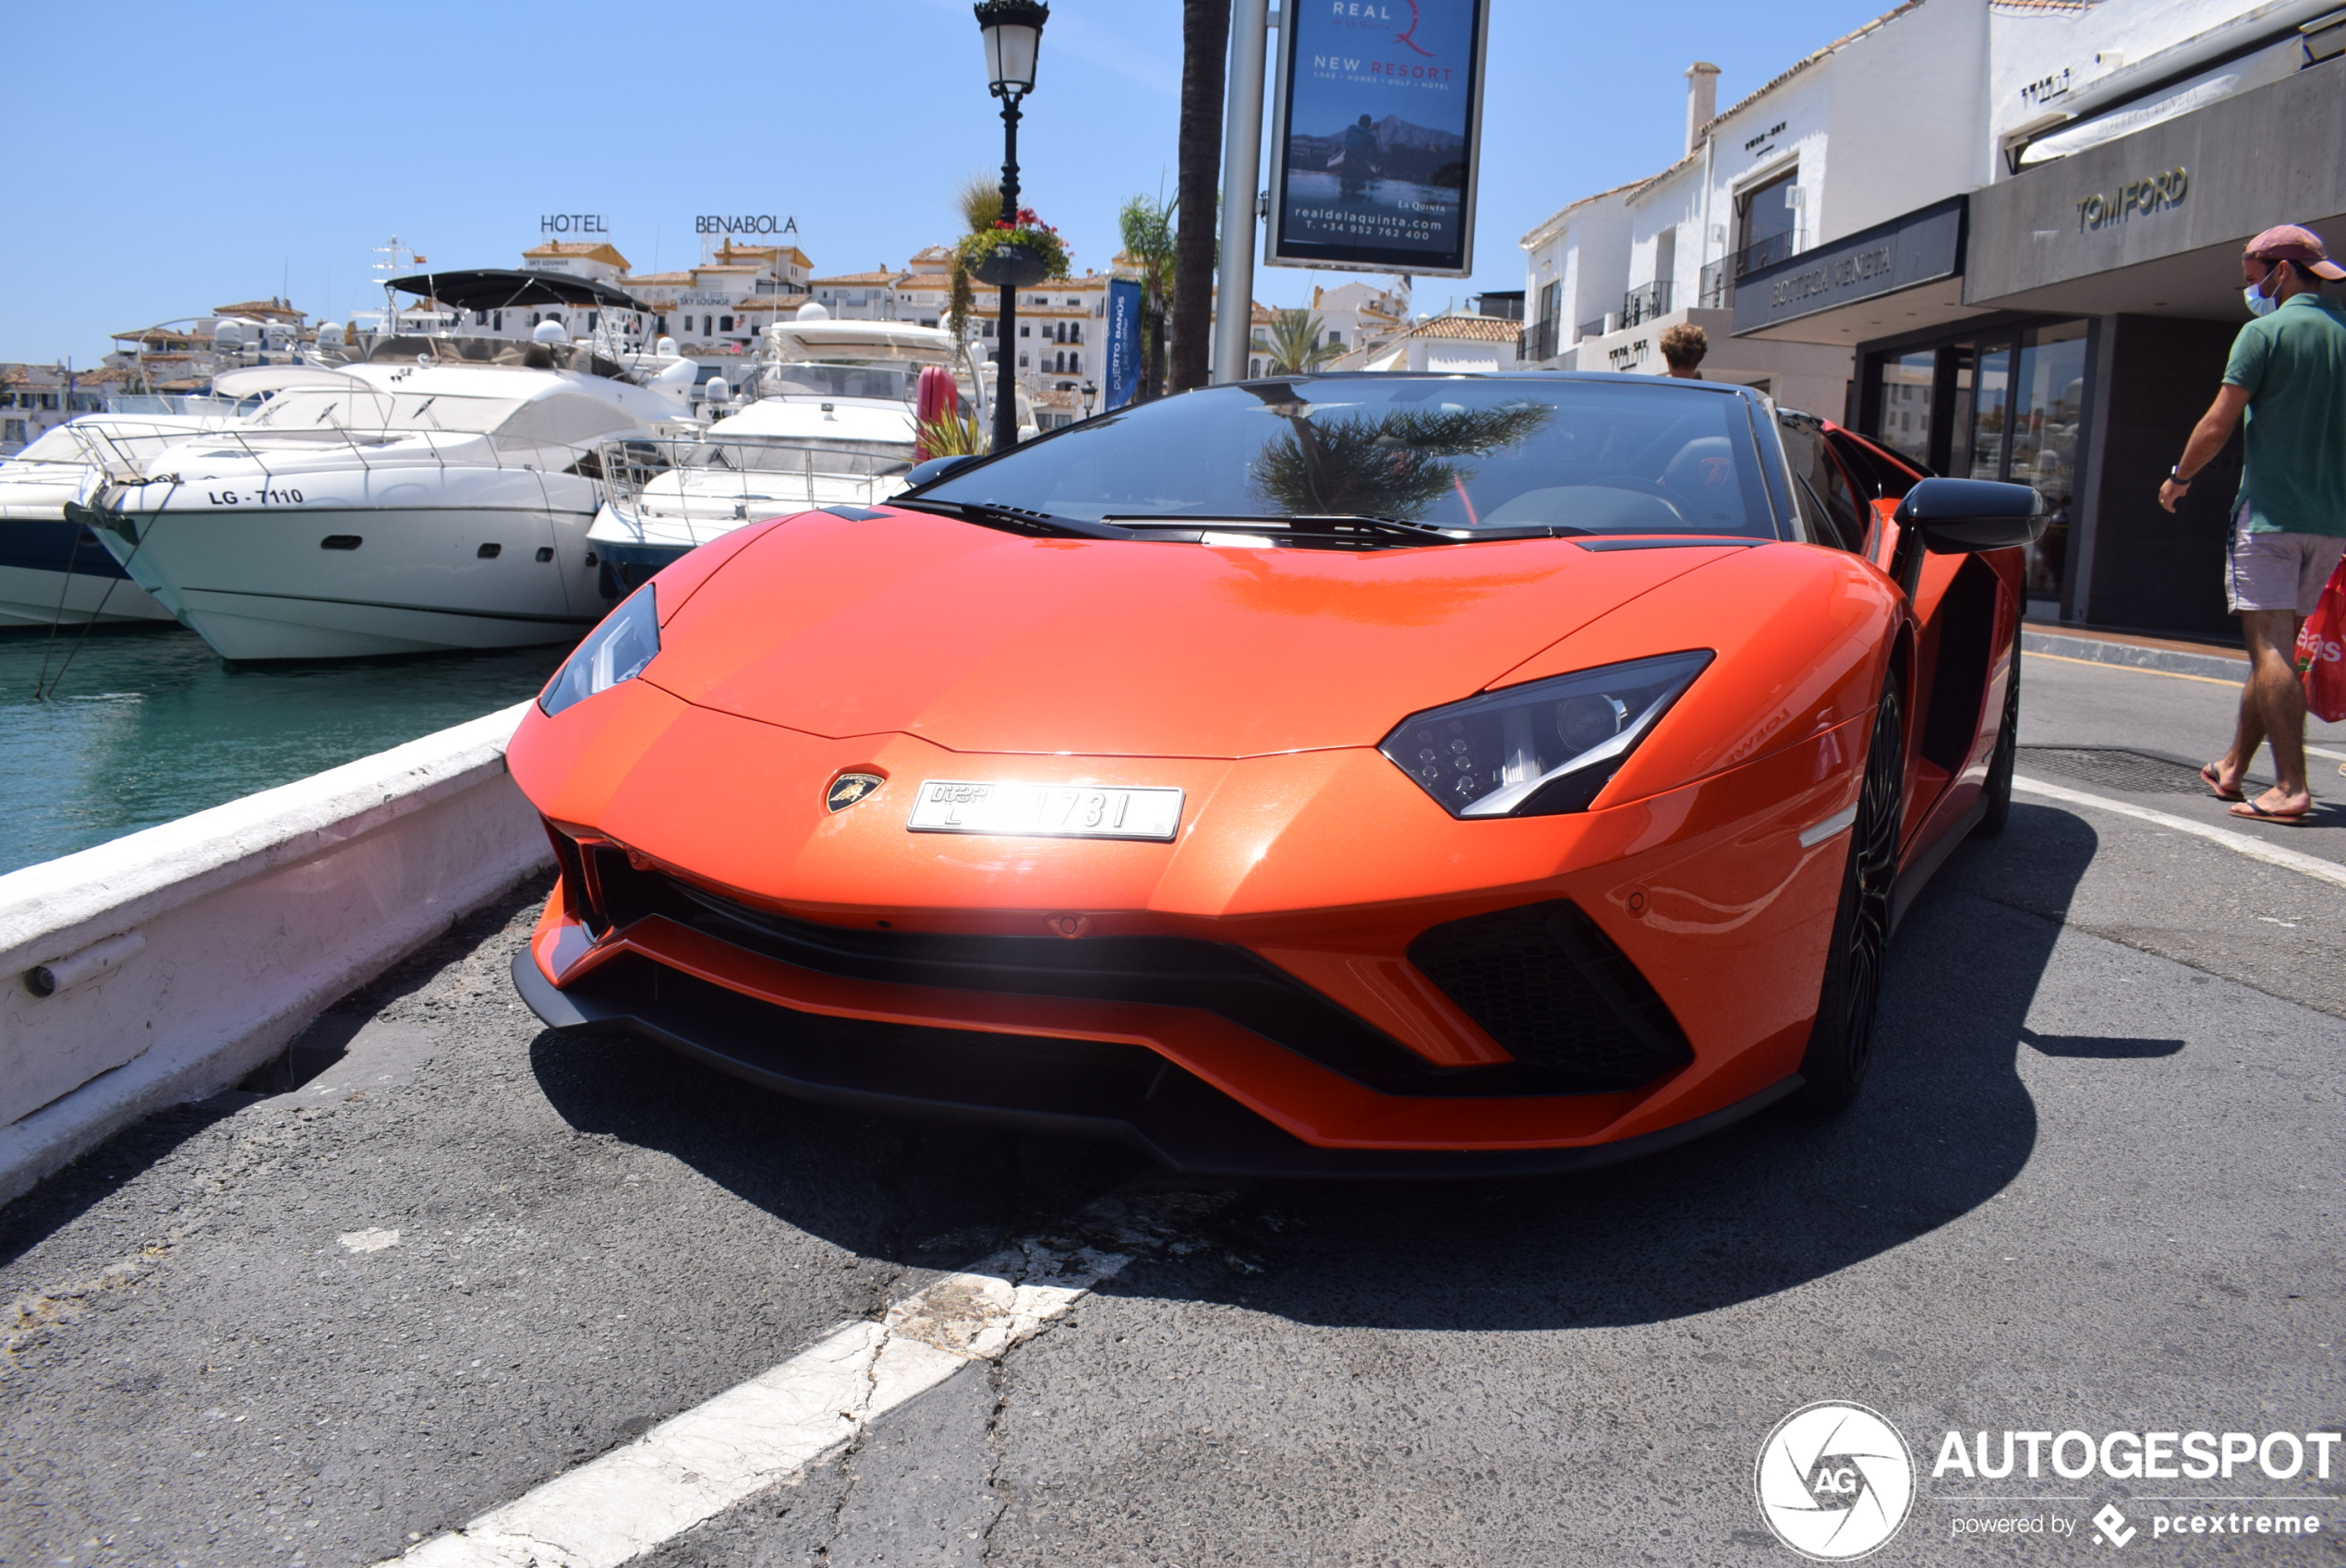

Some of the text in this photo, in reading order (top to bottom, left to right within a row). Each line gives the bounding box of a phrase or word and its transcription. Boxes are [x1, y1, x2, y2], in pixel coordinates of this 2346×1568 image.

[1333, 1, 1391, 20] REAL
[1314, 55, 1453, 80] NEW RESORT
[1314, 71, 1449, 90] LAKE HOMES GOLF HOTEL
[2076, 166, 2188, 231] TOM FORD
[541, 214, 797, 234] HOTEL BENABOLA
[1295, 208, 1442, 231] realdelaquinta.com
[1306, 221, 1430, 240] T. +34 952 762 400
[1772, 246, 1891, 308] BOTTEGA VENETA
[680, 297, 730, 306] SKY LOUNGE
[1113, 296, 1125, 391] PUERTO BANÚS
[208, 490, 239, 505] LG
[255, 488, 304, 504] 7110
[840, 775, 881, 785] LAMBORGHINI
[944, 805, 962, 826] L
